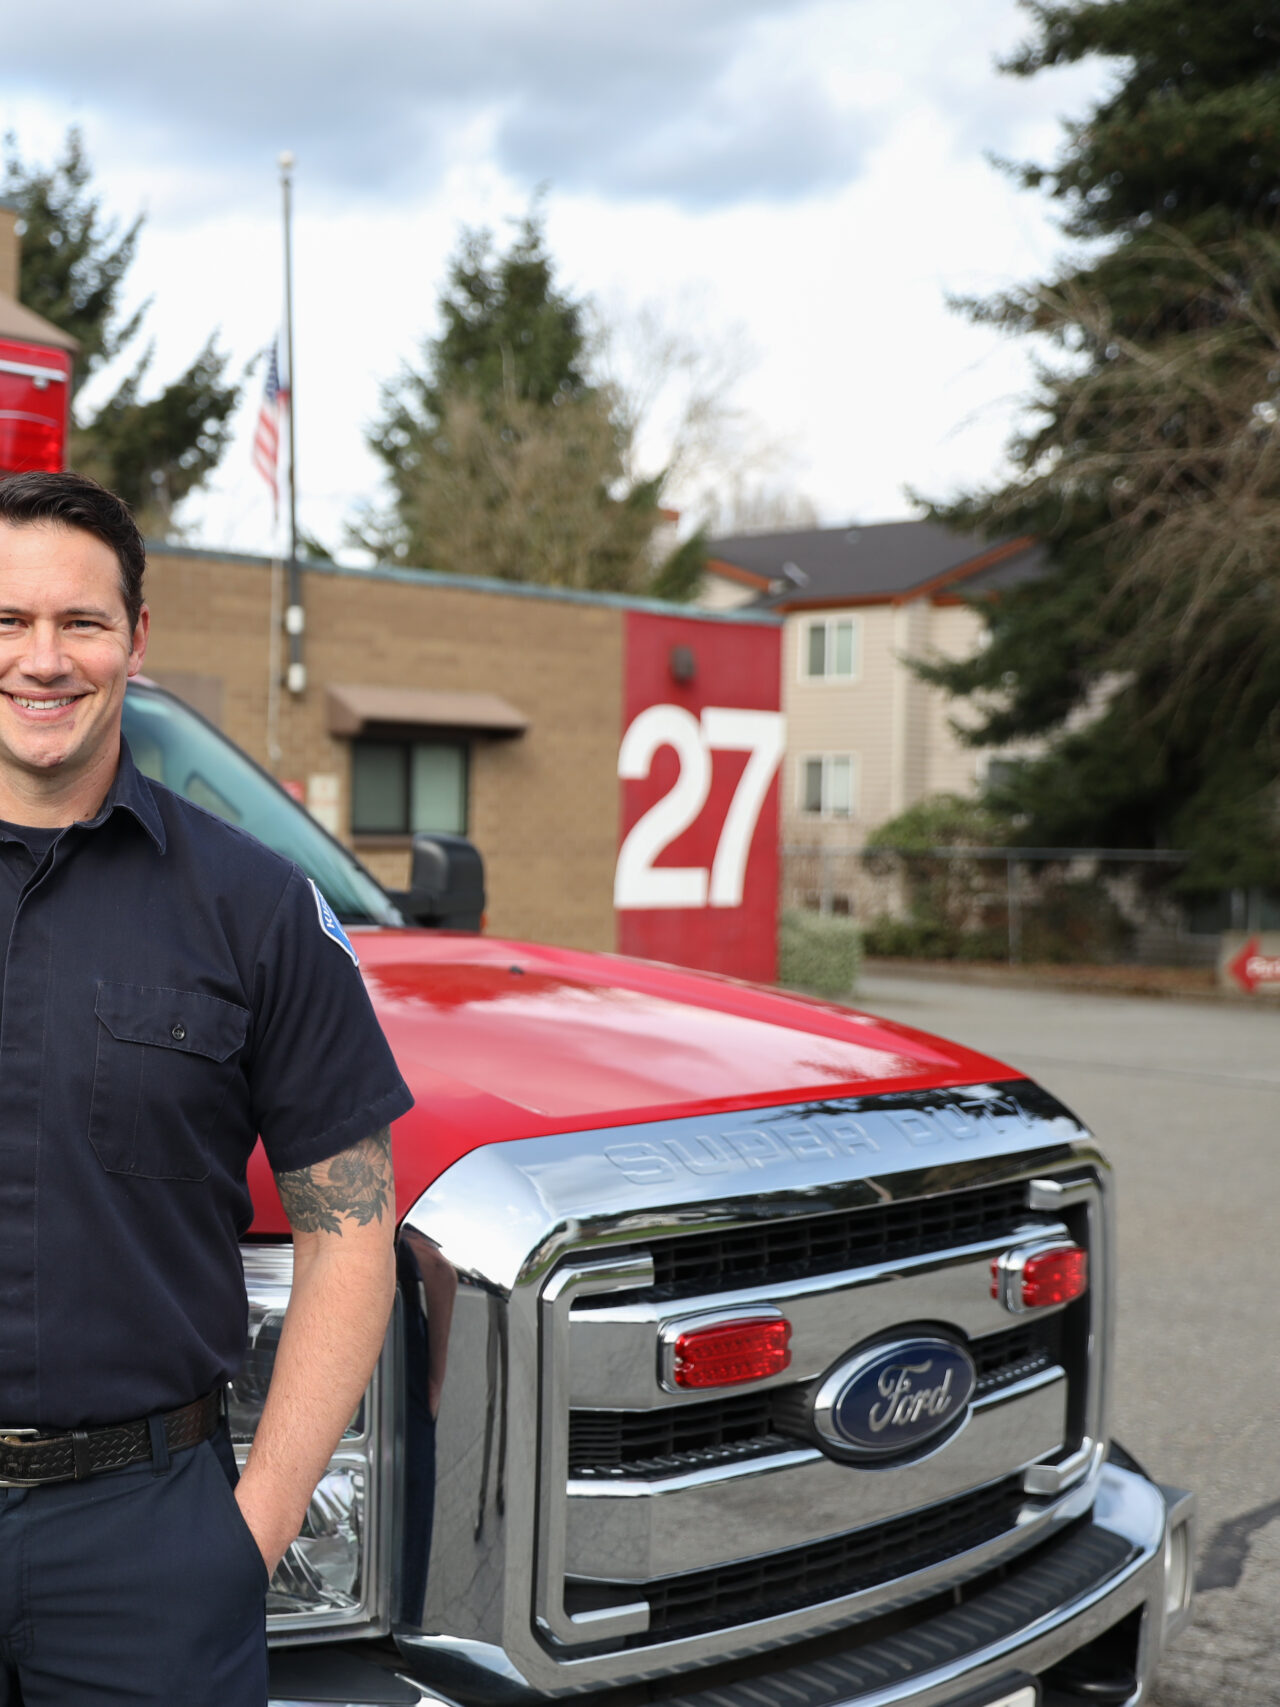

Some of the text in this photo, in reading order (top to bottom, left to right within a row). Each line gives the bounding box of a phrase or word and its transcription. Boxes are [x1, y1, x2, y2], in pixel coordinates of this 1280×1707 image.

[613, 703, 789, 910] 27
[603, 1095, 1036, 1186] SUPER DUTY
[868, 1359, 954, 1433] Ford
